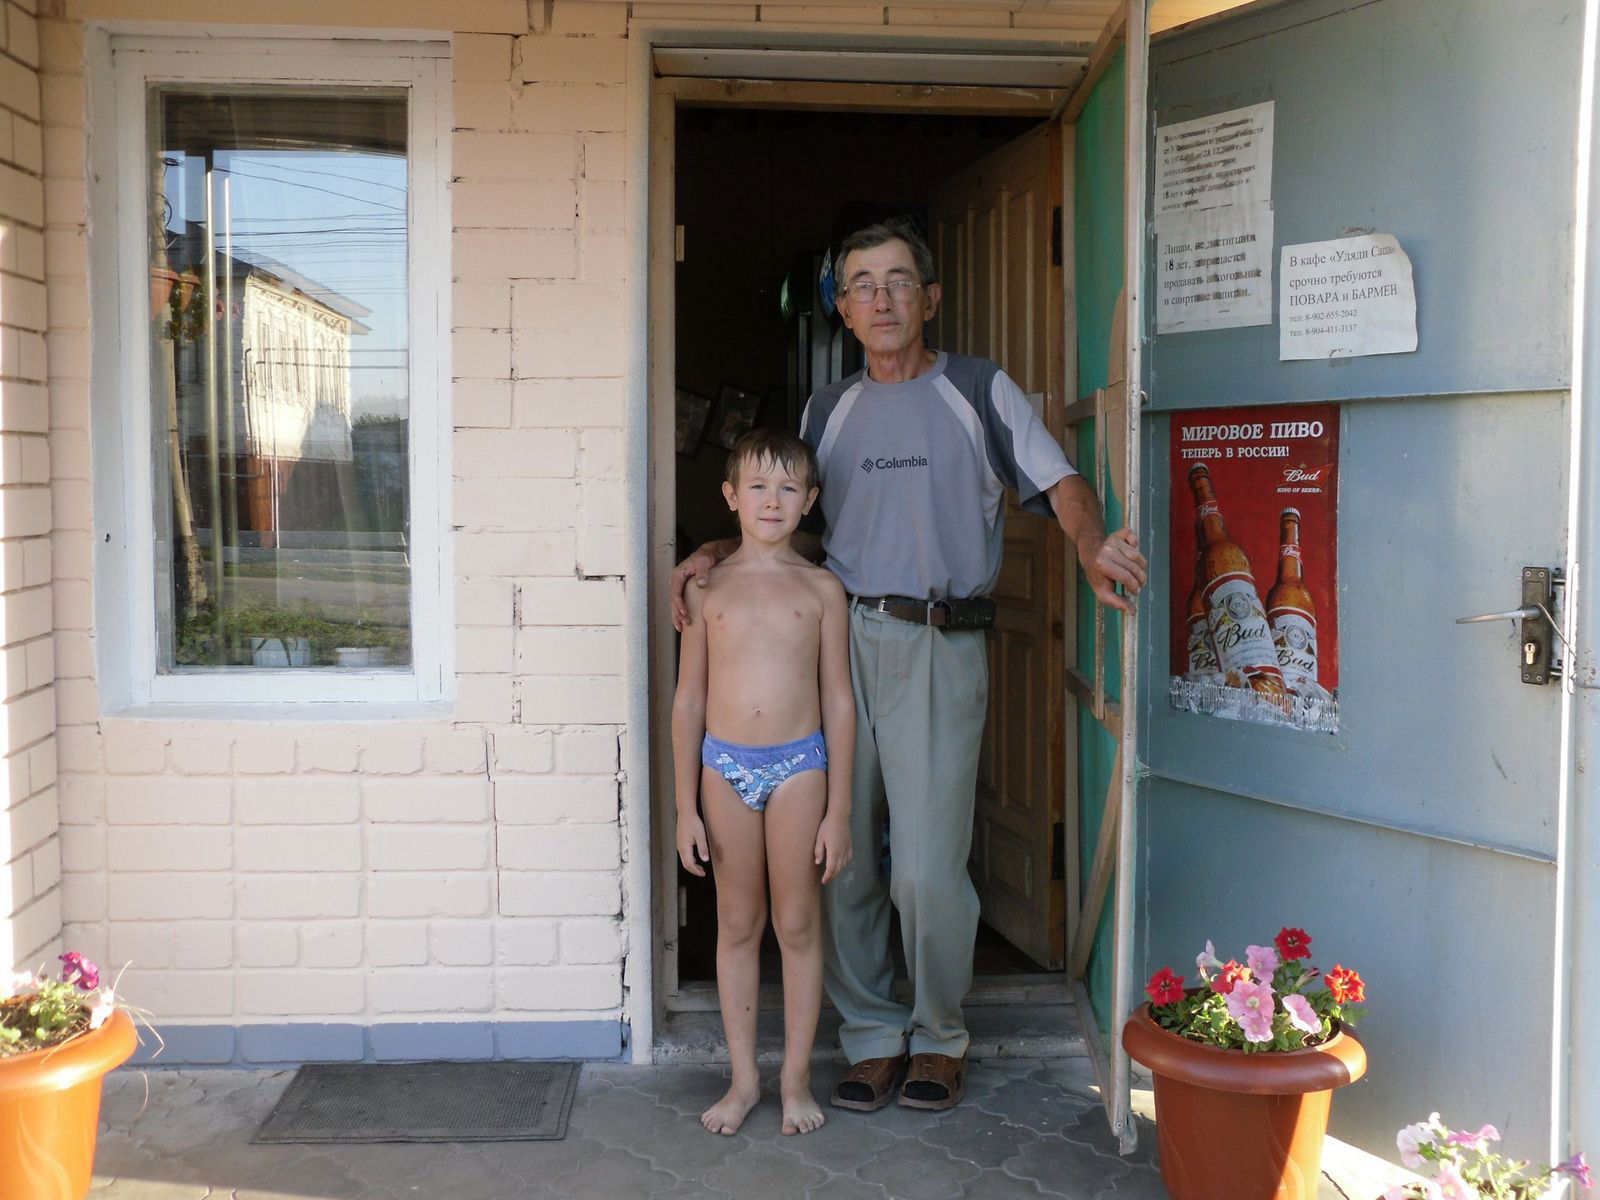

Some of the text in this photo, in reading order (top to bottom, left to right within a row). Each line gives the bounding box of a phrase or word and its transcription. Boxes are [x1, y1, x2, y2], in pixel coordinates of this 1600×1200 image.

[1164, 244, 1192, 255] Лицам,
[1194, 241, 1205, 250] не
[1165, 259, 1174, 271] 18
[1175, 262, 1191, 270] лет,
[1290, 256, 1297, 267] В
[1300, 253, 1326, 267] кафе
[1164, 276, 1204, 290] продавать
[1289, 269, 1382, 289] срочно требуются
[1290, 284, 1398, 306] ПОВАРА и БАРМЕН
[1181, 421, 1324, 441] МИРОВОЕ ПИВО
[1181, 446, 1290, 459] ТЕПЕРЬ В РОССИИ!
[876, 456, 928, 469] Columbia
[1284, 469, 1321, 482] Bud
[1217, 623, 1266, 652] Bud
[1277, 649, 1314, 672] Bud
